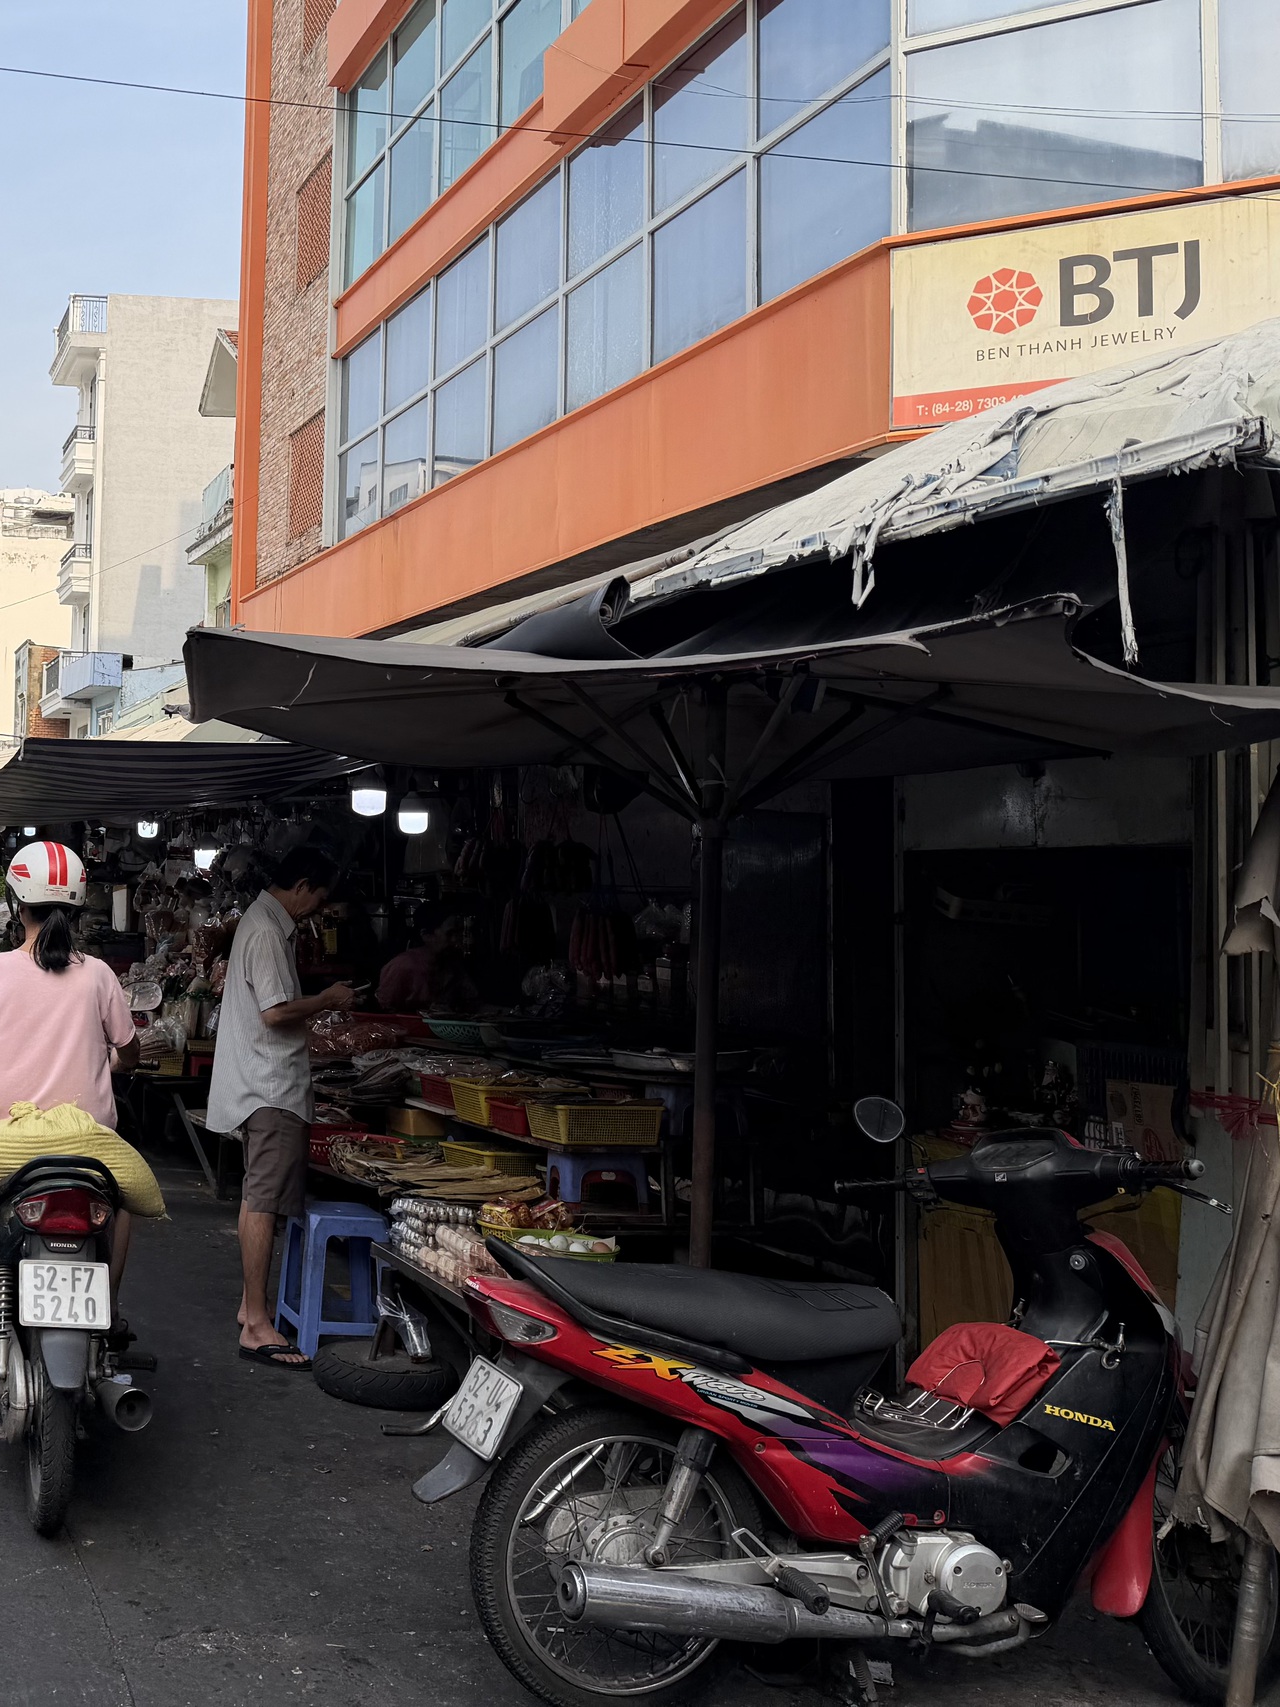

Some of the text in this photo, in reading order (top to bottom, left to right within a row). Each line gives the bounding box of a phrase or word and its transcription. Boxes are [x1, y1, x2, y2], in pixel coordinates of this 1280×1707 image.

[1059, 239, 1200, 327] BTJ
[976, 326, 1177, 362] BEN THANH JEWELRY
[916, 405, 928, 416] T:
[932, 400, 973, 416] (84-28)
[33, 1266, 94, 1293] 52-F7
[33, 1294, 96, 1323] 5240
[697, 1388, 717, 1398] URBAN
[1044, 1404, 1116, 1431] HONDA
